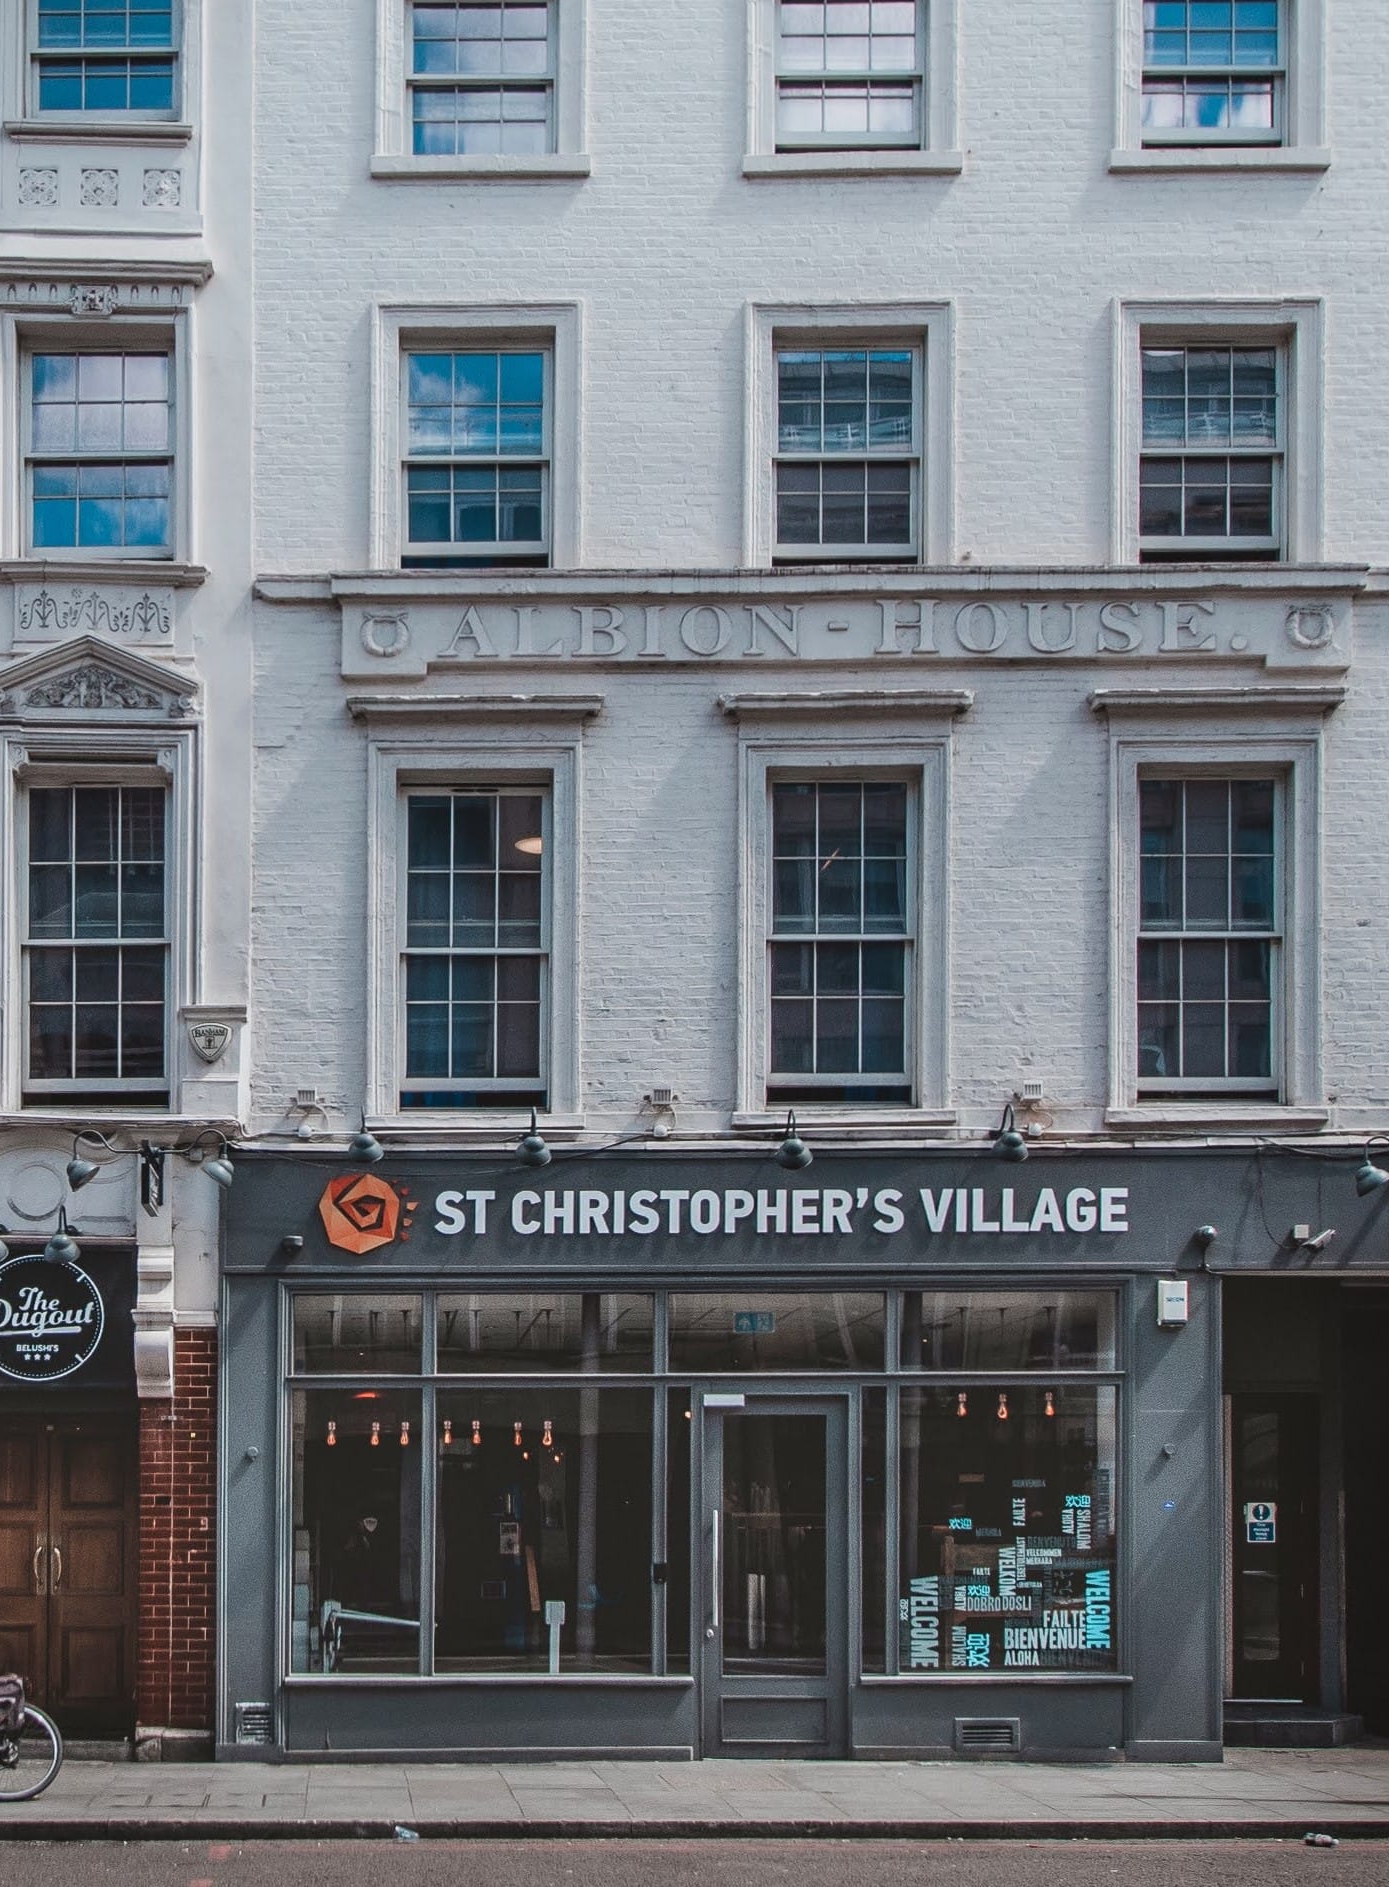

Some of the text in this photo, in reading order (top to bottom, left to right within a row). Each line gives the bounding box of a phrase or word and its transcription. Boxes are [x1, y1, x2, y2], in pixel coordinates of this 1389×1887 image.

[437, 603, 805, 659] ALBION
[433, 1187, 1129, 1235] ST CHRISTOPHER'S VILLAGE
[19, 1286, 61, 1311] The
[15, 1343, 60, 1353] BELUSHI'S
[1062, 1508, 1075, 1535] ALOHA
[1076, 1509, 1092, 1550] SHALOM
[998, 1547, 1016, 1597] WELKOM
[910, 1575, 940, 1669] WELCOME
[1043, 1609, 1086, 1628] FAILTE
[1084, 1569, 1111, 1650] WELCOME
[952, 1625, 967, 1667] SHALOM
[966, 1633, 991, 1668] 欢迎
[1004, 1627, 1087, 1650] BIENVENUE
[1004, 1650, 1040, 1666] ALOHA
